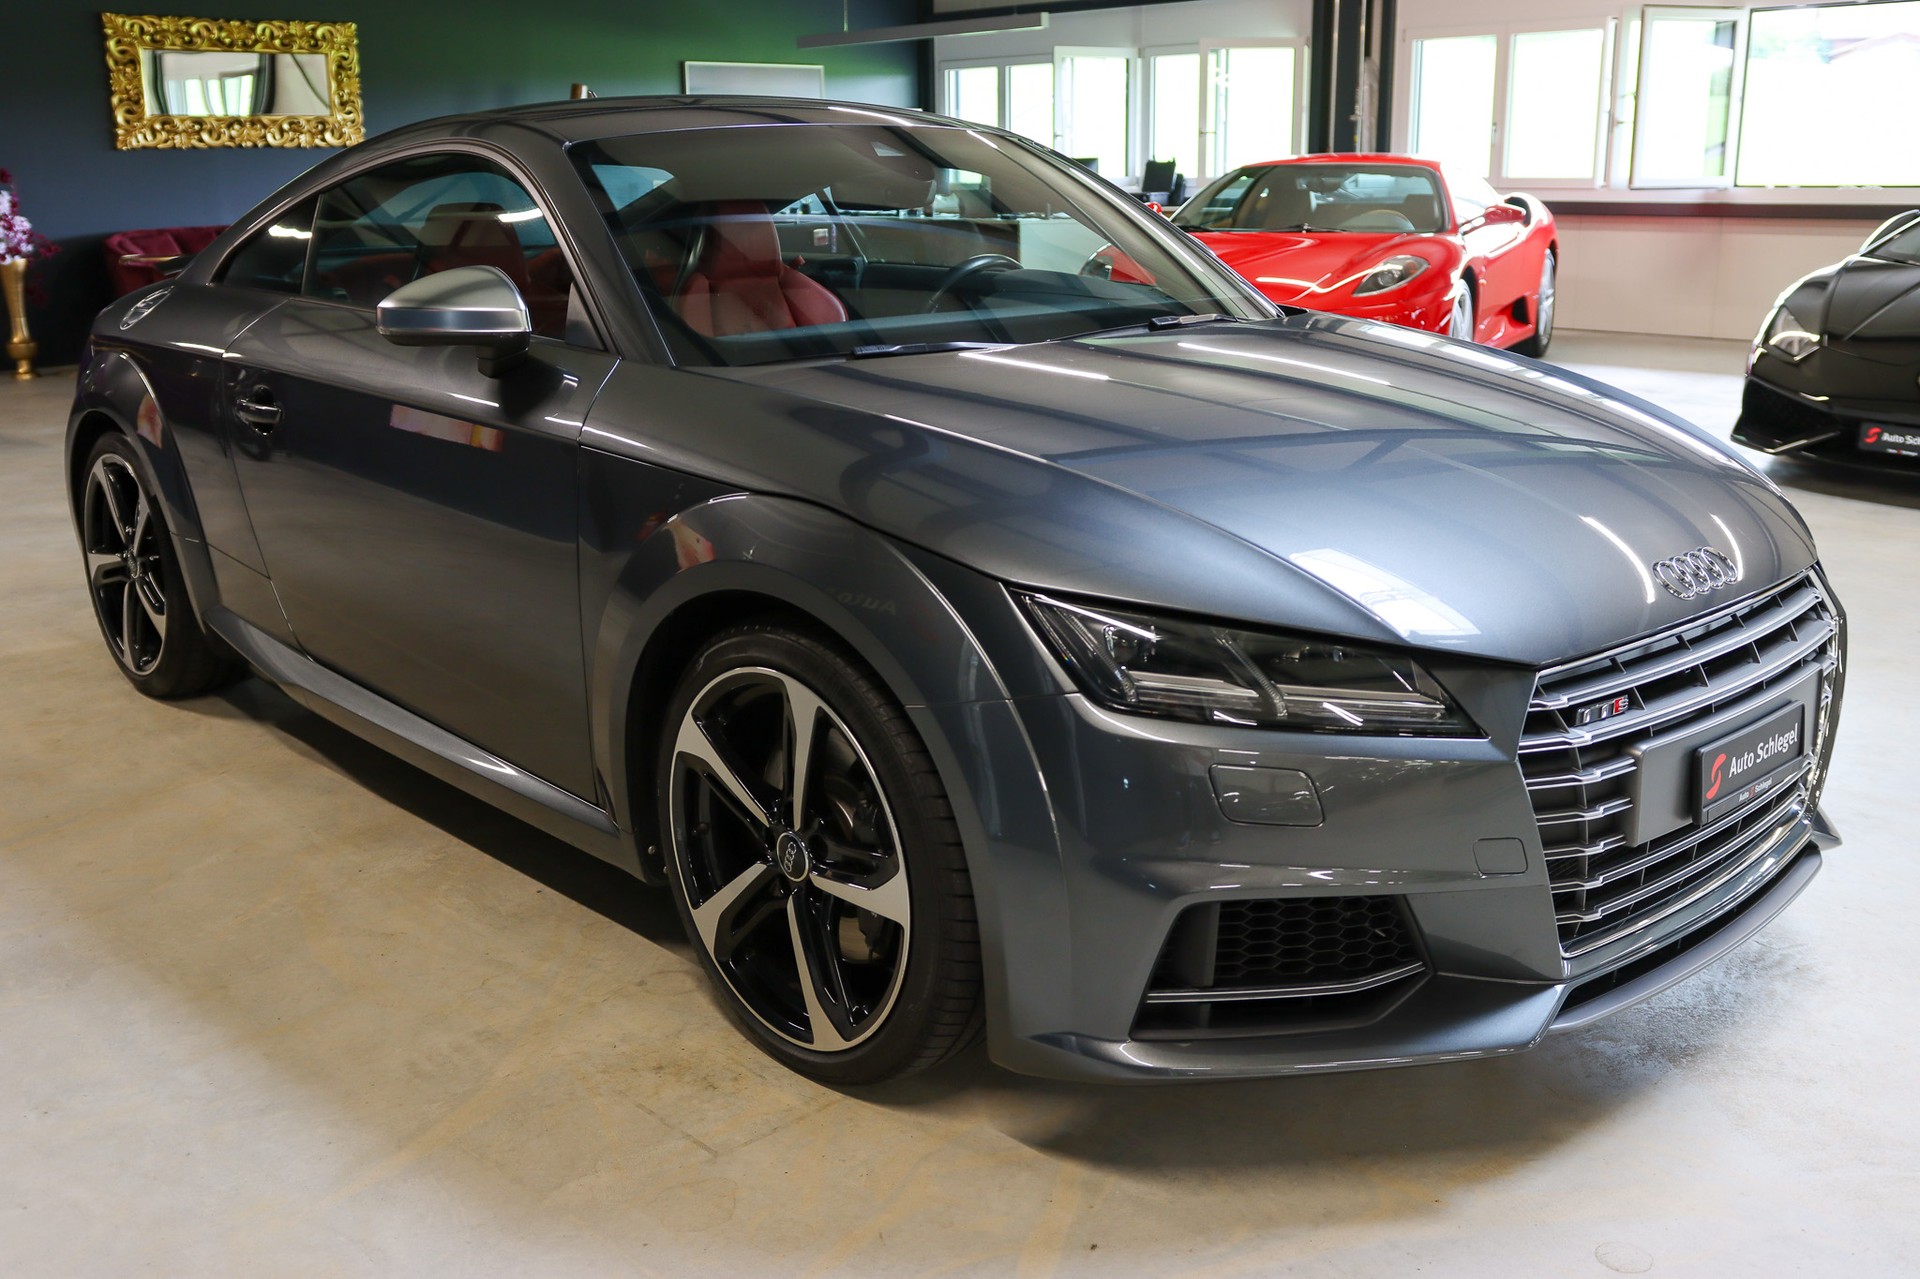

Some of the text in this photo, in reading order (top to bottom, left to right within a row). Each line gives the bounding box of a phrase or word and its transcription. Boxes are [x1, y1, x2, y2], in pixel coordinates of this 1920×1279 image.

[1881, 432, 1905, 443] Auto
[1728, 722, 1798, 778] Auto Schlegel
